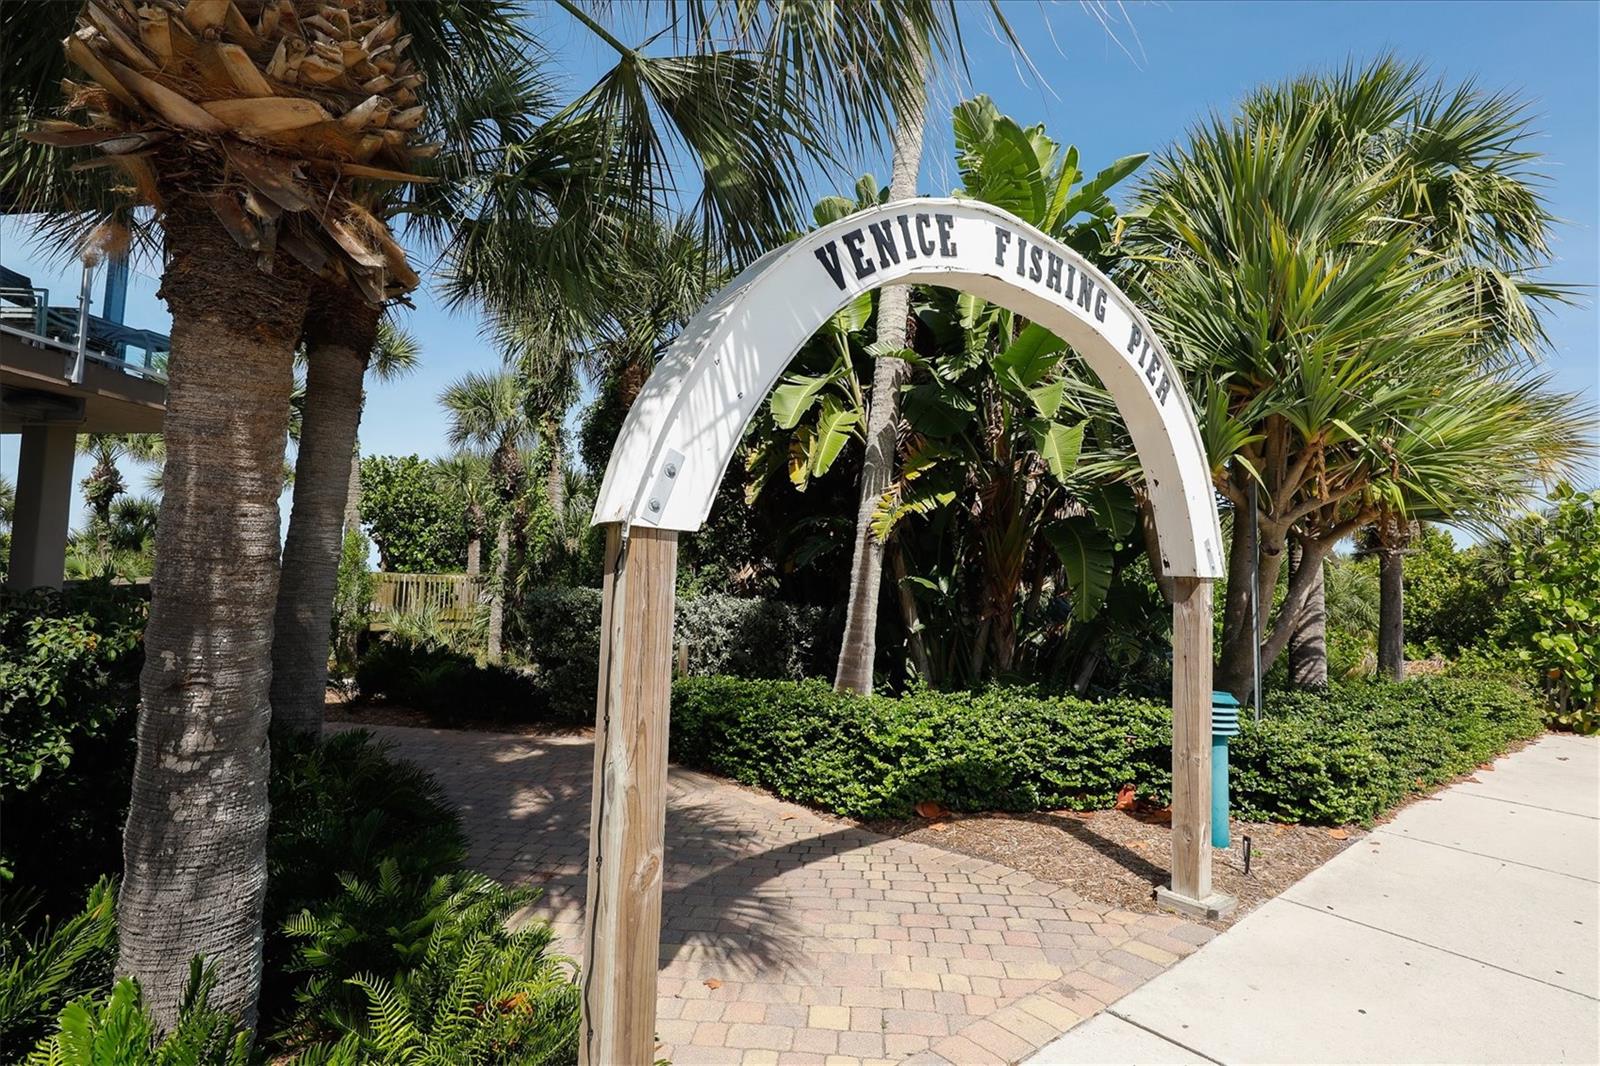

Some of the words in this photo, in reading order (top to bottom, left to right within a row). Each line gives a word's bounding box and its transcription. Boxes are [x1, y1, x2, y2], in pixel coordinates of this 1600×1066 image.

[814, 213, 957, 291] VENICE
[995, 226, 1108, 323] FISHING
[1127, 321, 1172, 407] PIER
